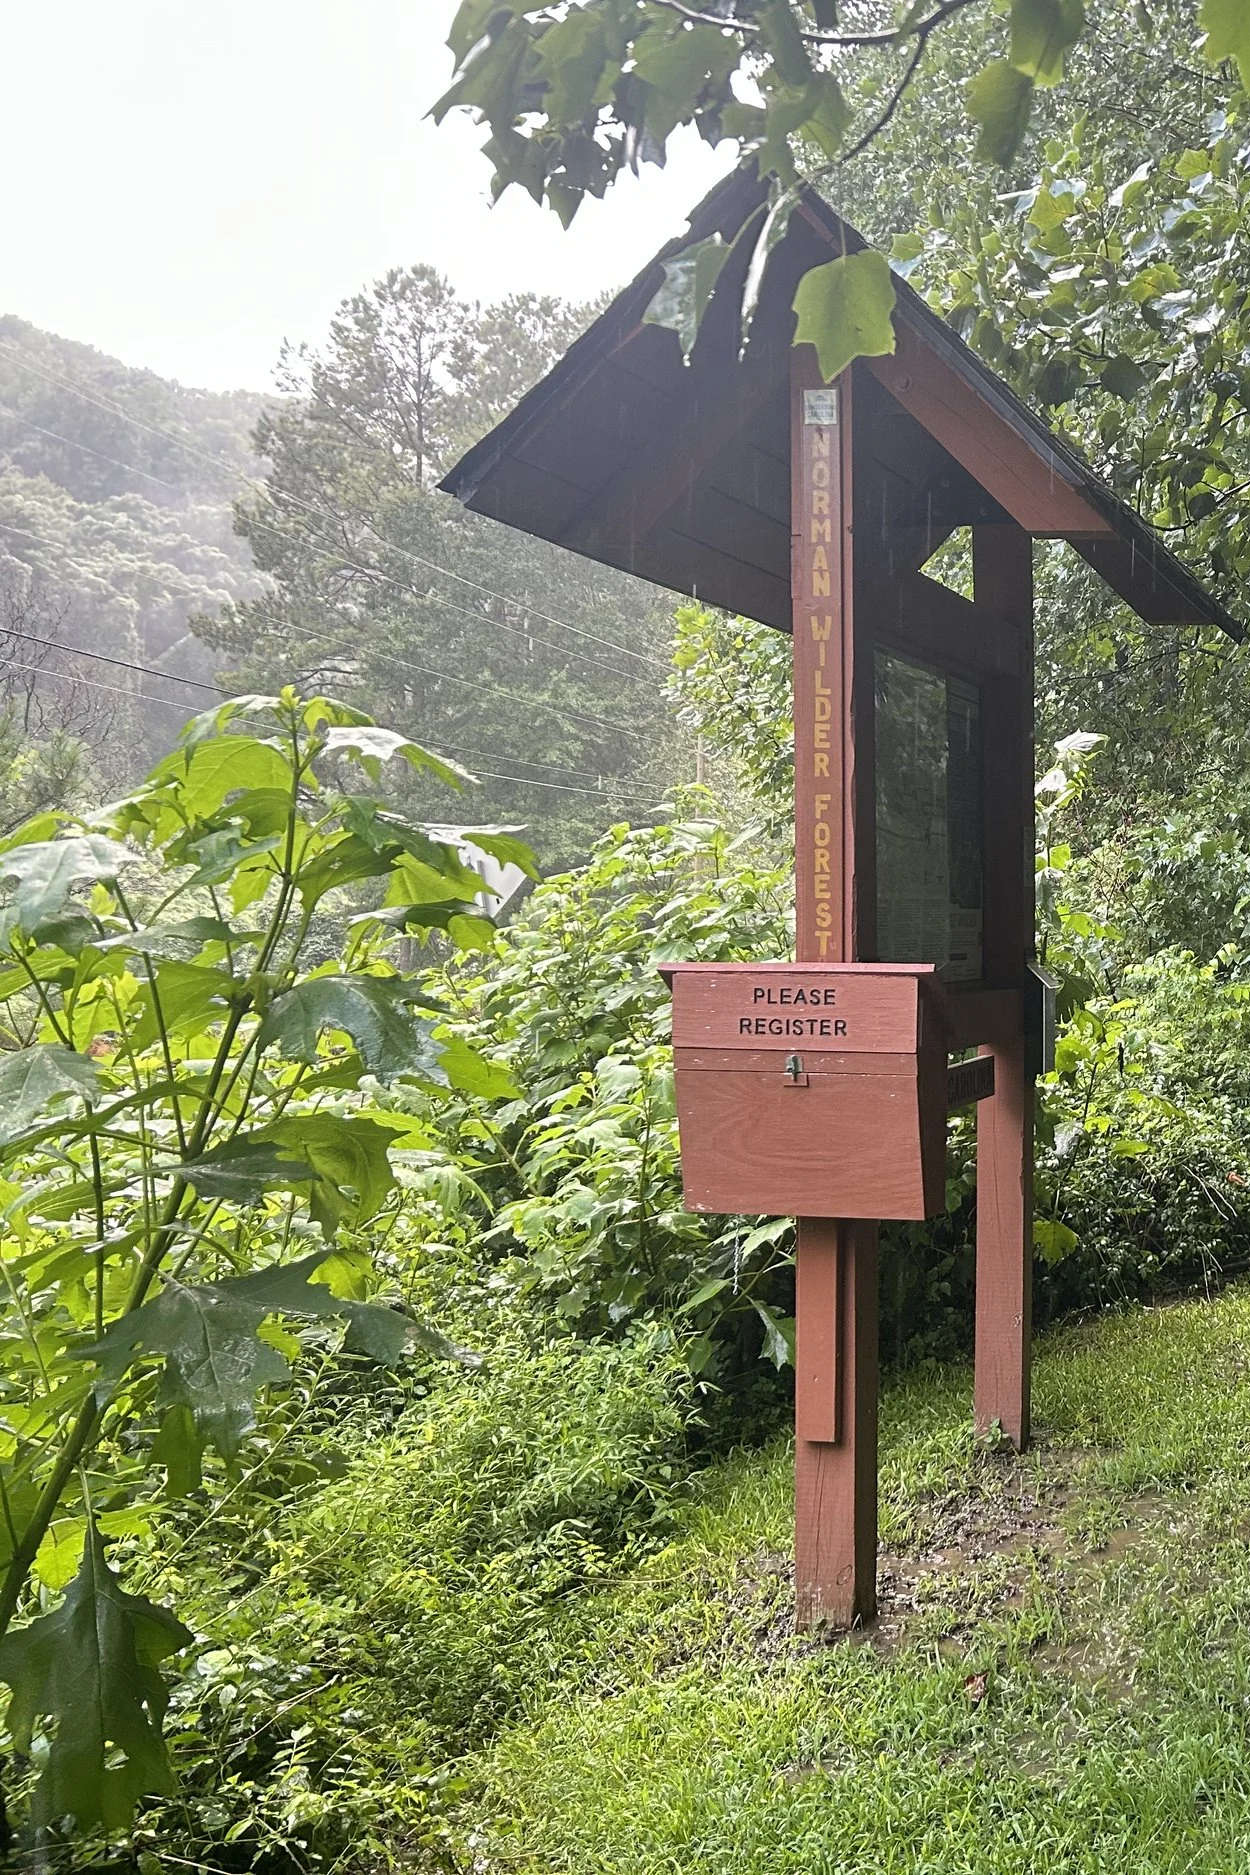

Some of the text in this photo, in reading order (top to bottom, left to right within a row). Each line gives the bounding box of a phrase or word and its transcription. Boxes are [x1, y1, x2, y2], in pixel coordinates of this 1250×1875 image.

[811, 431, 832, 597] NORMAN
[810, 615, 832, 777] WILDER
[814, 794, 832, 956] FOREST
[739, 1017, 847, 1037] REGISTER
[753, 987, 836, 1006] PLEASE
